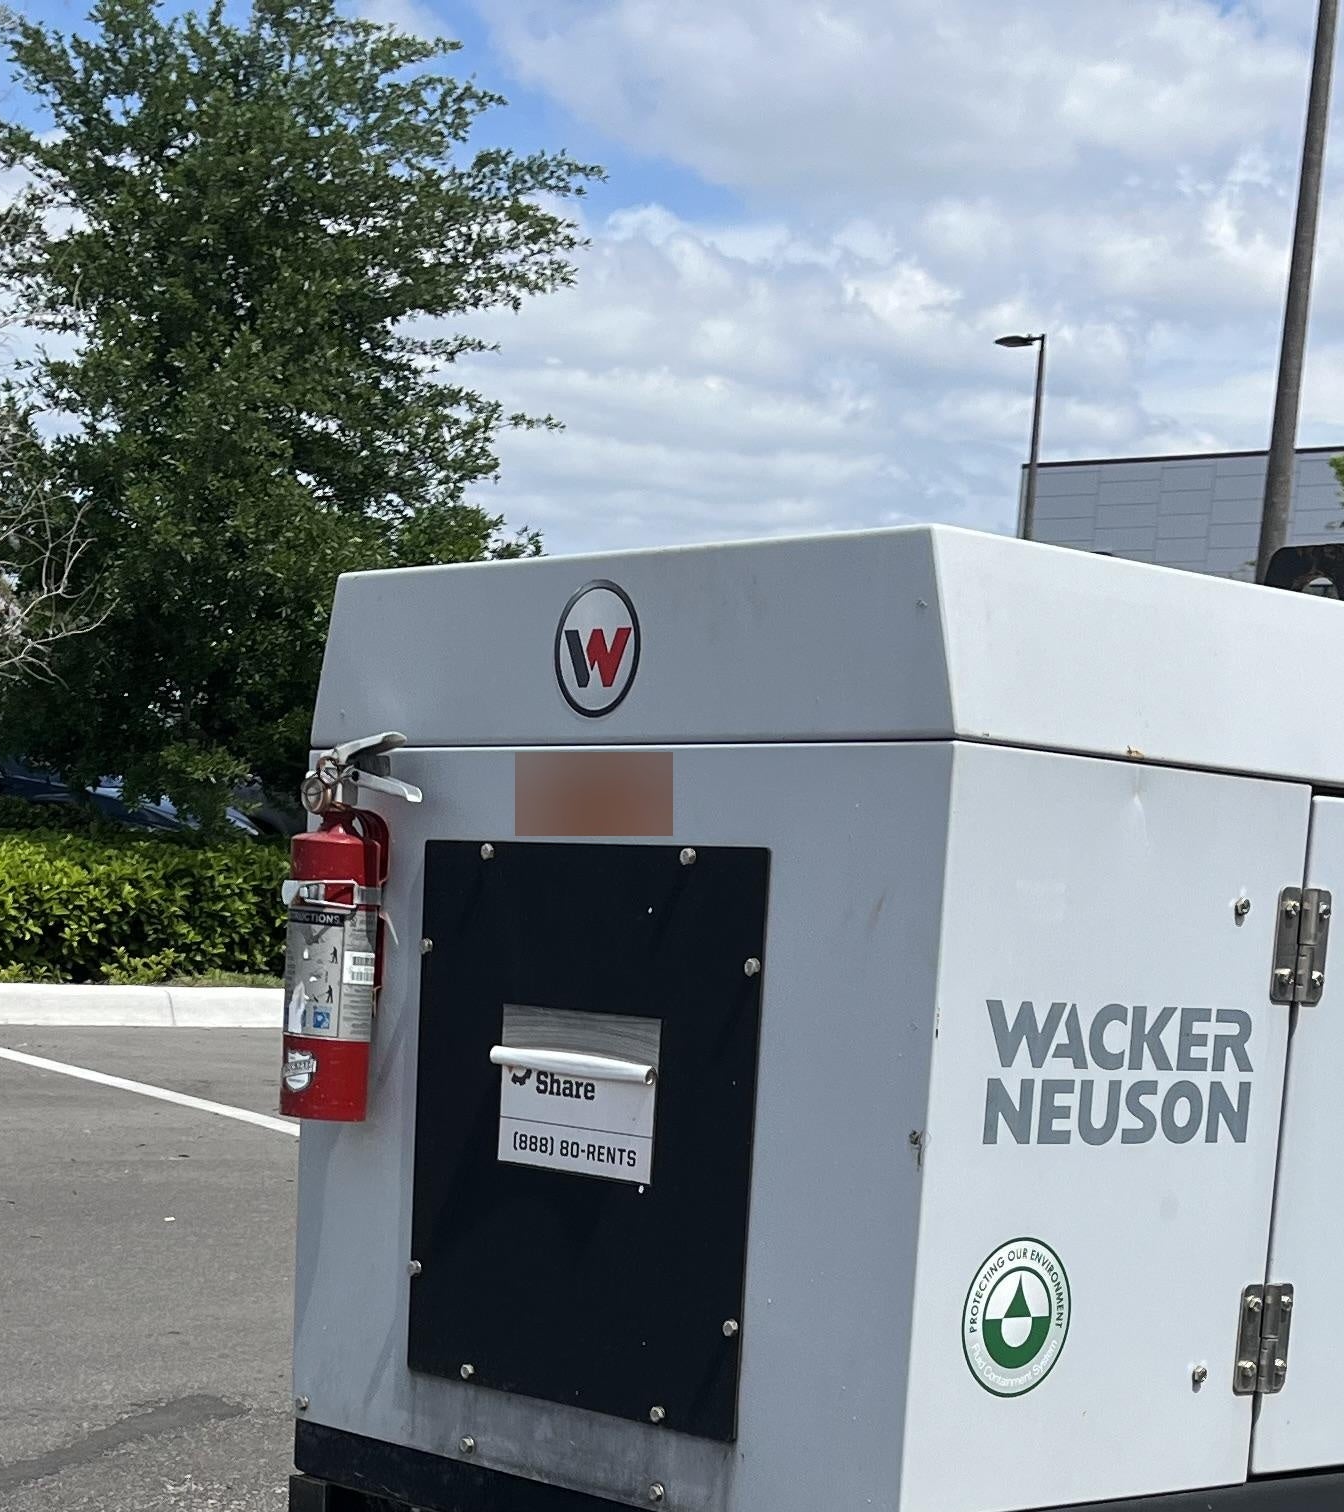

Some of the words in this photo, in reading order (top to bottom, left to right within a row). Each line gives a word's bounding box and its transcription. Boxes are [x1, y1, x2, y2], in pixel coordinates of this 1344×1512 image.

[985, 999, 1255, 1073] WACKER
[535, 1070, 596, 1101] Share
[982, 1077, 1253, 1147] NEUSON
[513, 1131, 554, 1156] (888)
[559, 1139, 637, 1167] 80-RENTS
[969, 1256, 1005, 1334] PROTECTING
[1007, 1247, 1028, 1262] OUR
[1030, 1249, 1065, 1329] ENVIRONMENT
